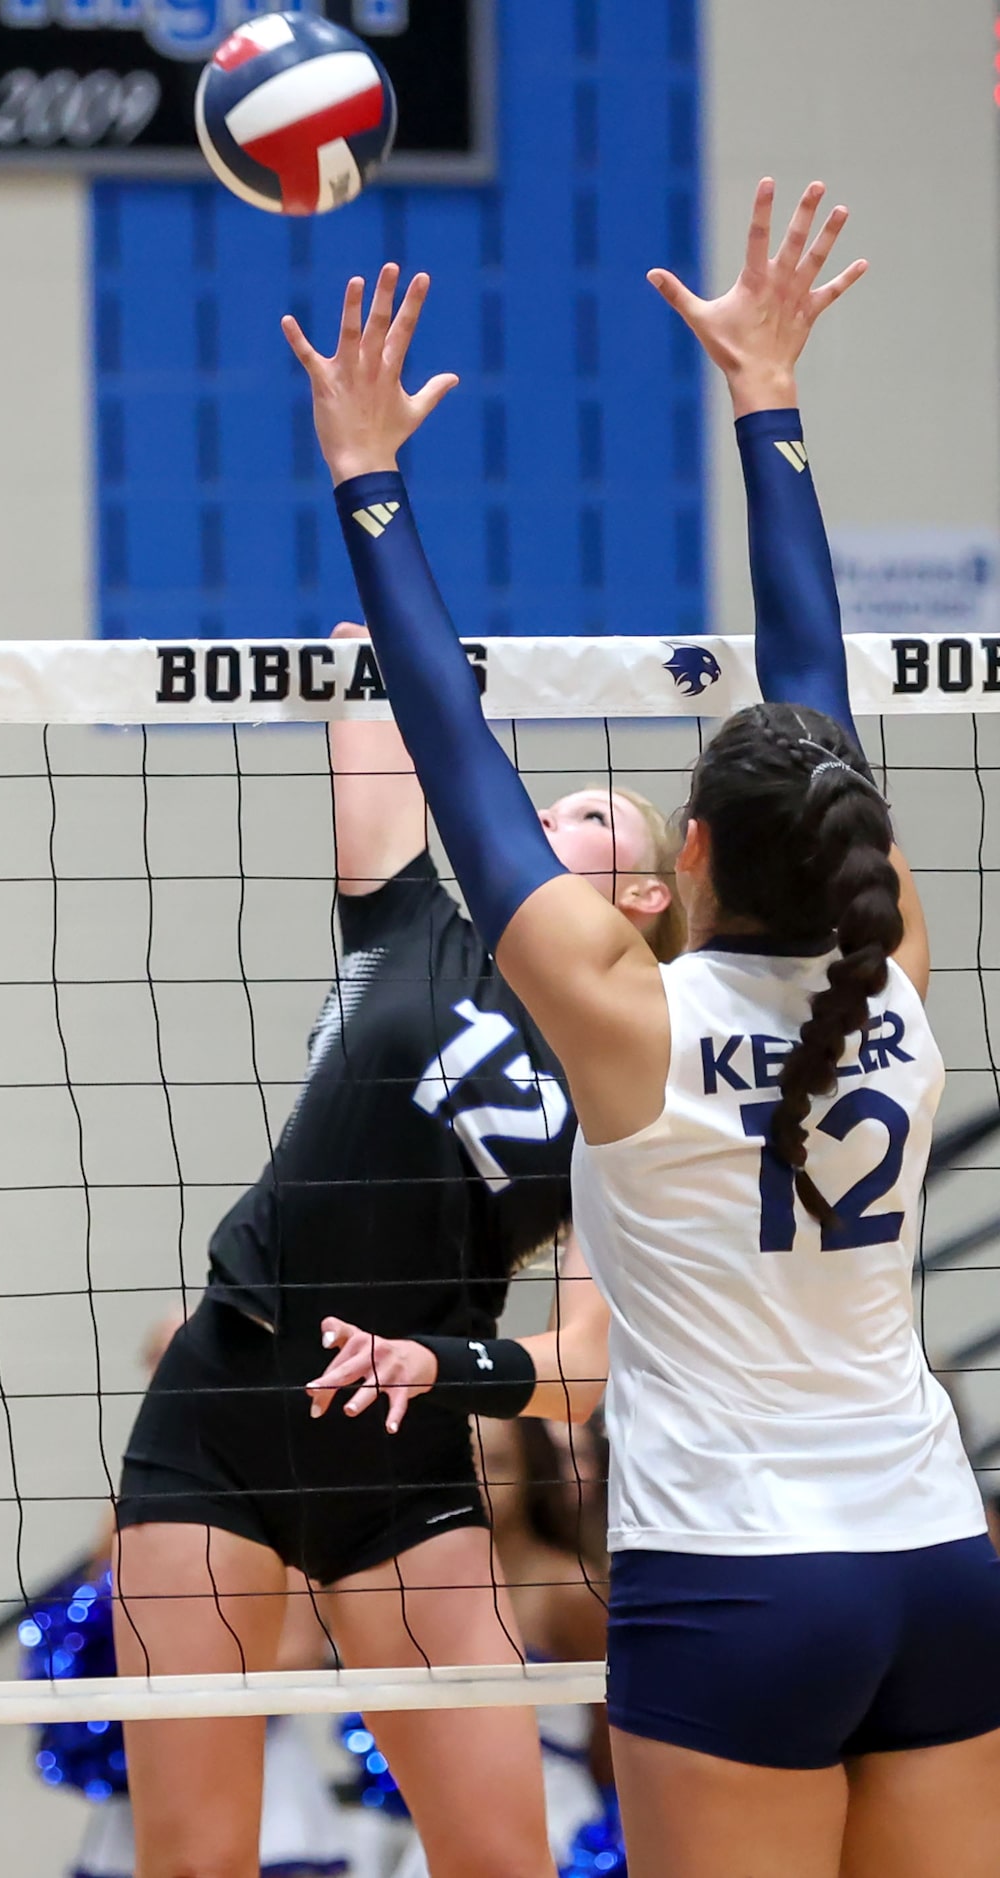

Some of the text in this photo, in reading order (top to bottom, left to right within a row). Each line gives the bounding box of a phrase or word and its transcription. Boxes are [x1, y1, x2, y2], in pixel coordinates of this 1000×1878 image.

[155, 643, 488, 703] BOBCA
[412, 998, 568, 1194] 12
[699, 1010, 916, 1095] KEER
[739, 1086, 910, 1253] 12
